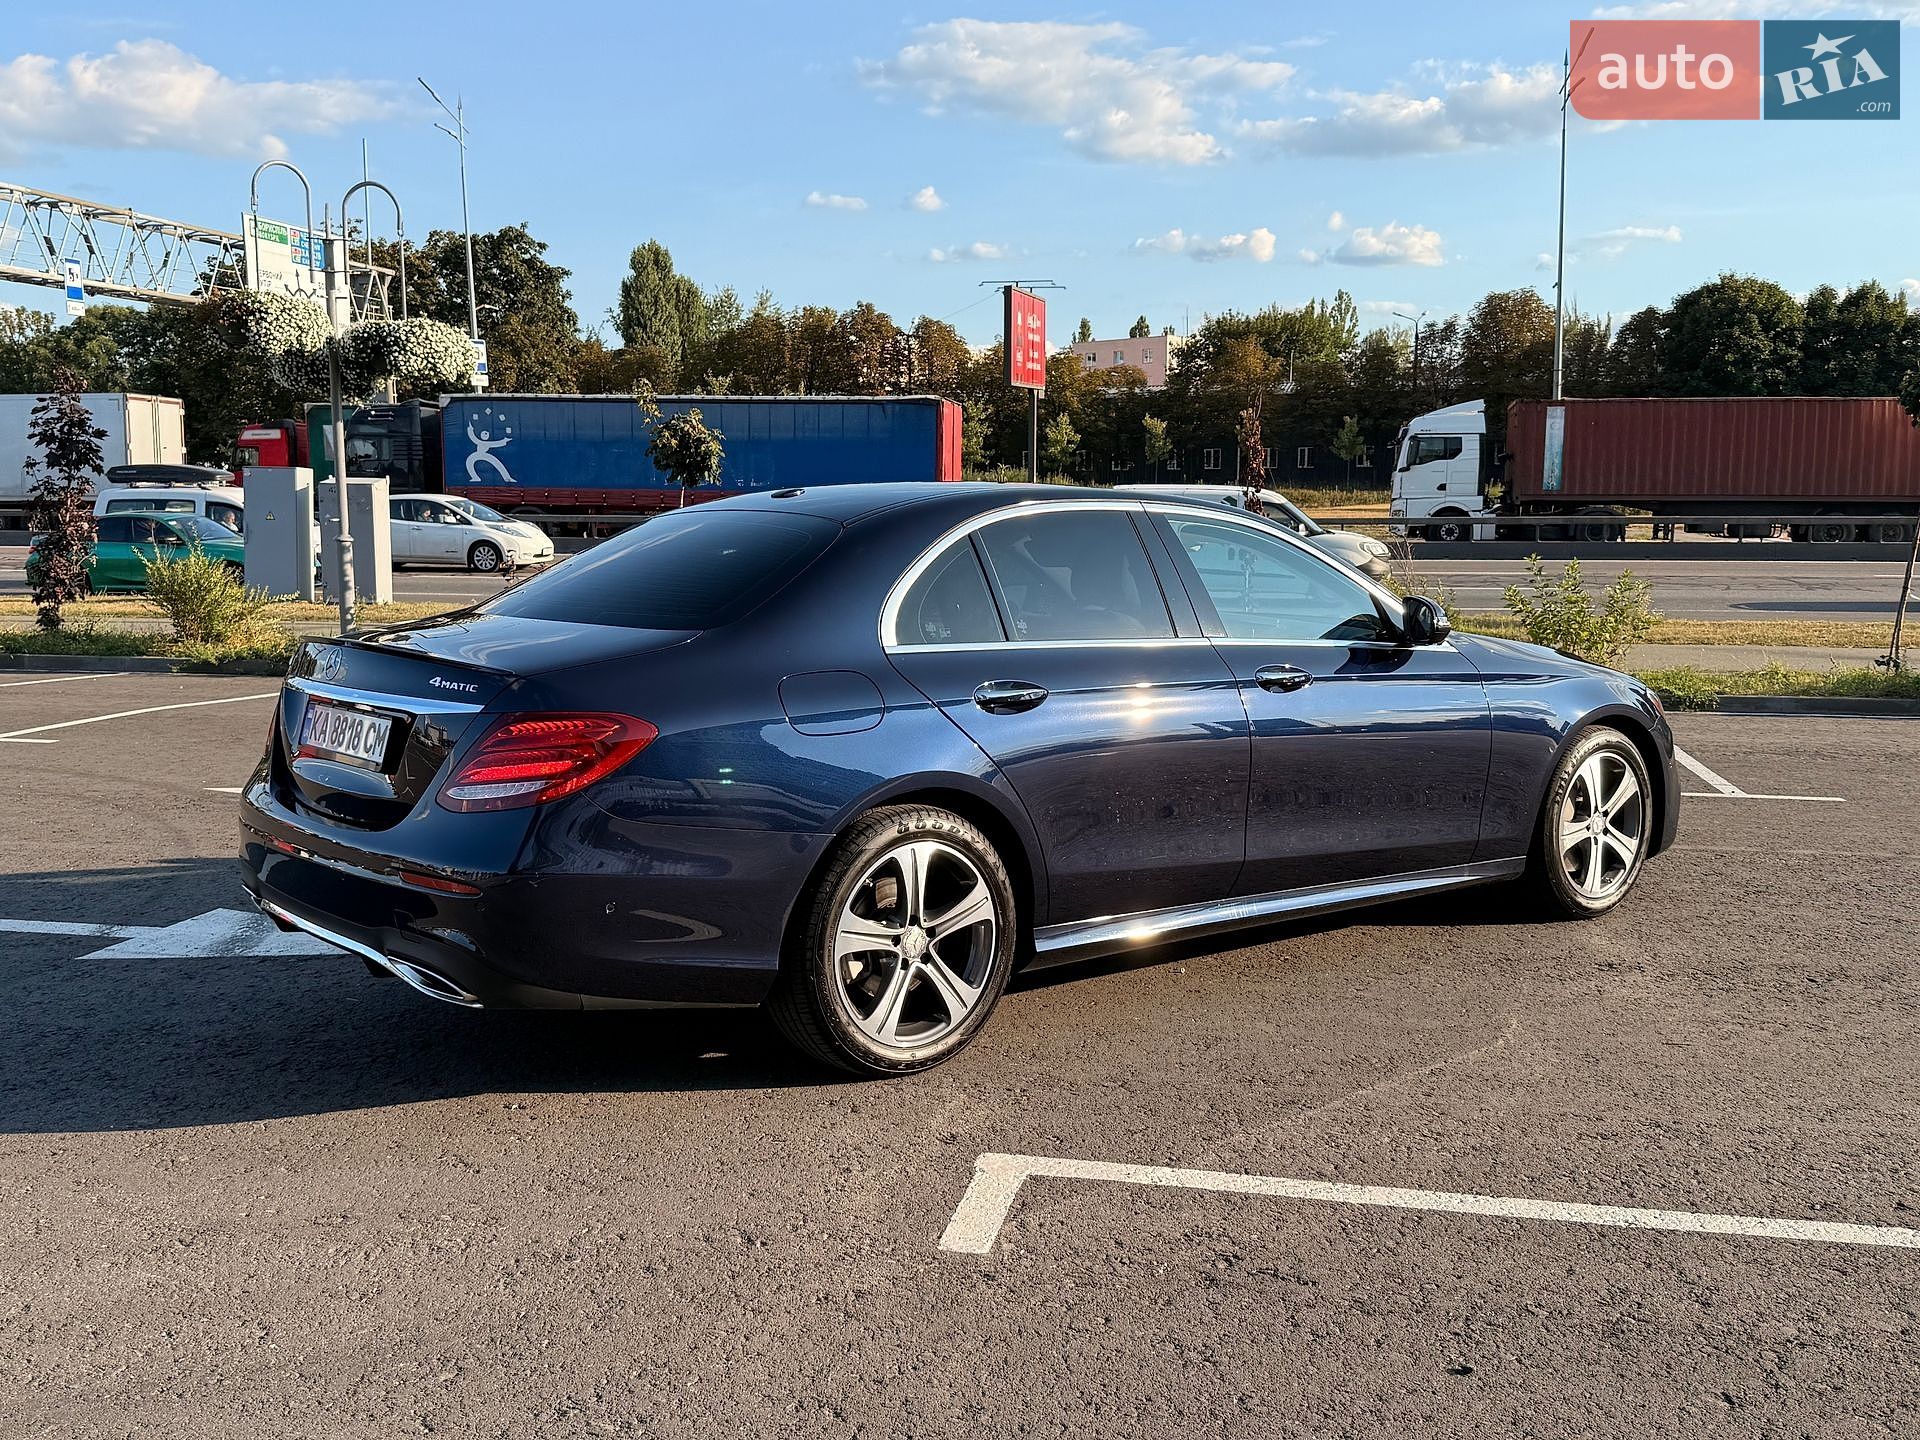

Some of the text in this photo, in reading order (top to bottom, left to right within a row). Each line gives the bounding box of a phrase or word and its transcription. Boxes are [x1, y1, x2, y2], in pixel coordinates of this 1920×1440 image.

[429, 676, 479, 693] 4MATIC
[309, 709, 389, 757] KA 8818 CM
